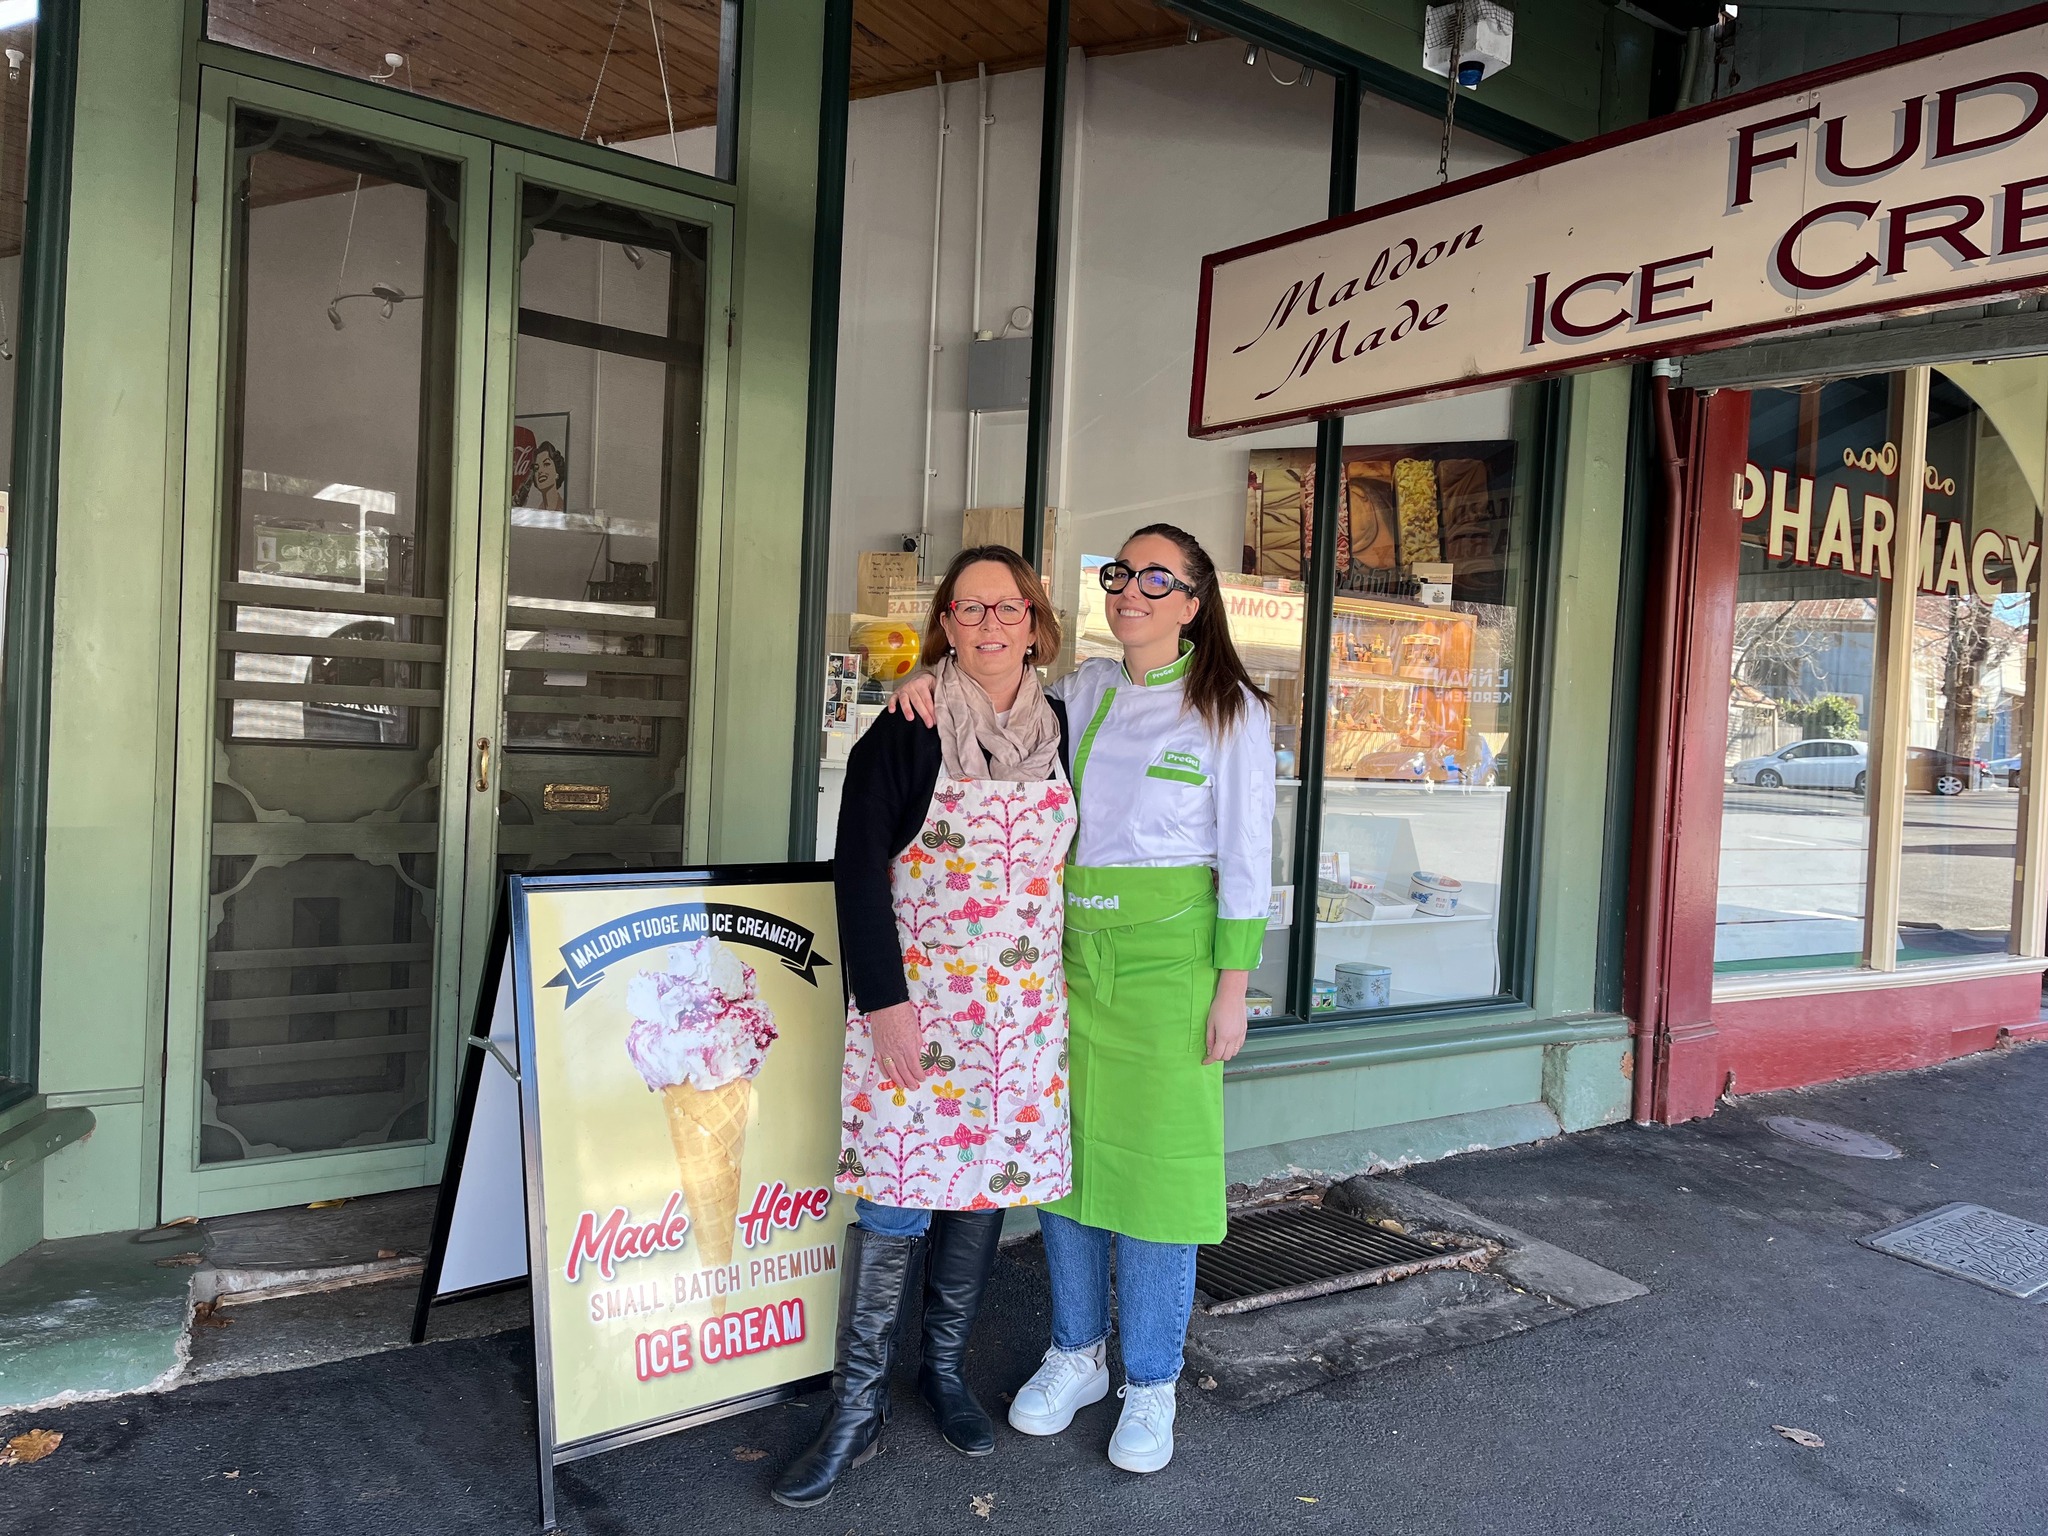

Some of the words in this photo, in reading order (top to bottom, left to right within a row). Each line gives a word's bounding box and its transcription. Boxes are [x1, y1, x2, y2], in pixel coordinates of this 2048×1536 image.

[1724, 71, 2048, 213] FUD
[1233, 224, 1484, 354] Maldon
[1524, 245, 1714, 350] ICE
[1255, 299, 1449, 401] Made
[1167, 752, 1199, 768] PreGel
[570, 925, 632, 970] MALDON
[633, 914, 680, 941] FUDGE
[682, 912, 710, 932] AND
[711, 912, 733, 933] ICE
[736, 915, 806, 953] CREAMERY
[1067, 891, 1119, 910] PreGel
[565, 1190, 688, 1281] Made
[738, 1182, 830, 1246] Here
[591, 1281, 665, 1322] SMALL
[674, 1263, 741, 1304] BATCH
[751, 1244, 837, 1287] PREMIUM
[638, 1328, 690, 1378] ICE
[703, 1301, 802, 1361] CREAM
